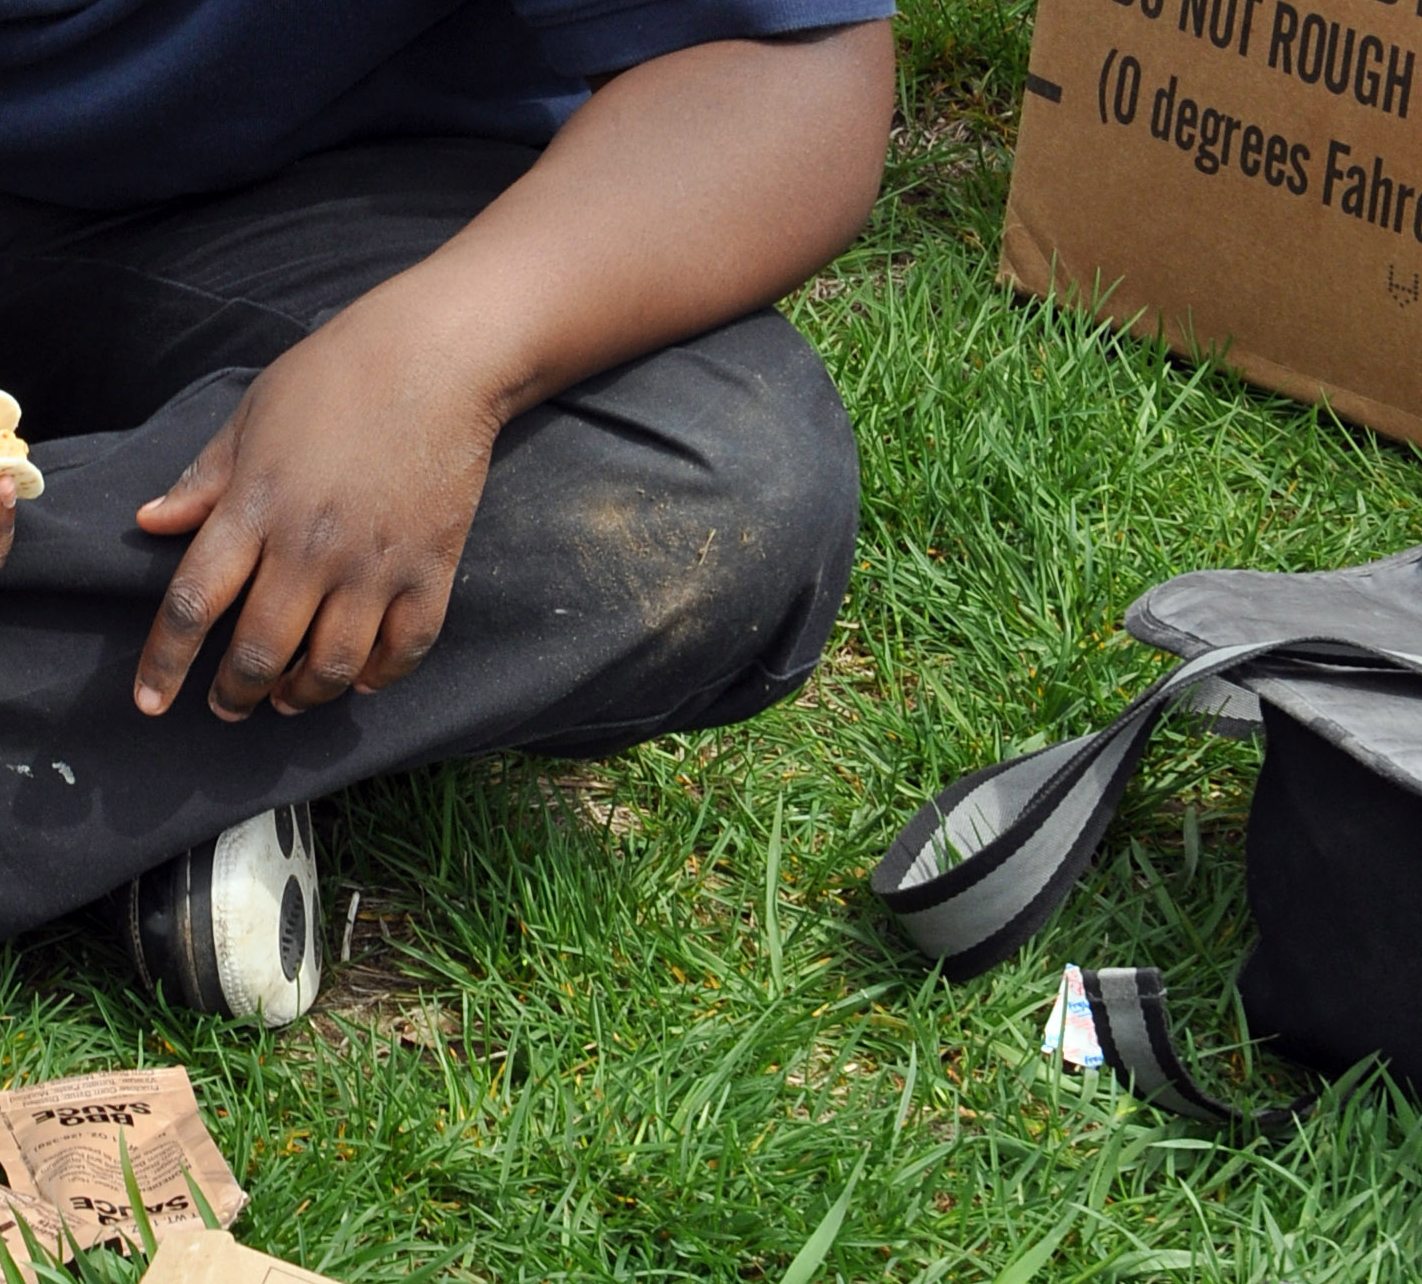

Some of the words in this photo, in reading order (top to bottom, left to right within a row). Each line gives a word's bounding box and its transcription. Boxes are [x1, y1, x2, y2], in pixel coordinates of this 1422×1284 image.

[1267, 1, 1415, 119] ROUGH
[1150, 74, 1311, 196] degrees
[31, 1102, 152, 1125] SAUCE
[59, 1113, 135, 1128] BBQ
